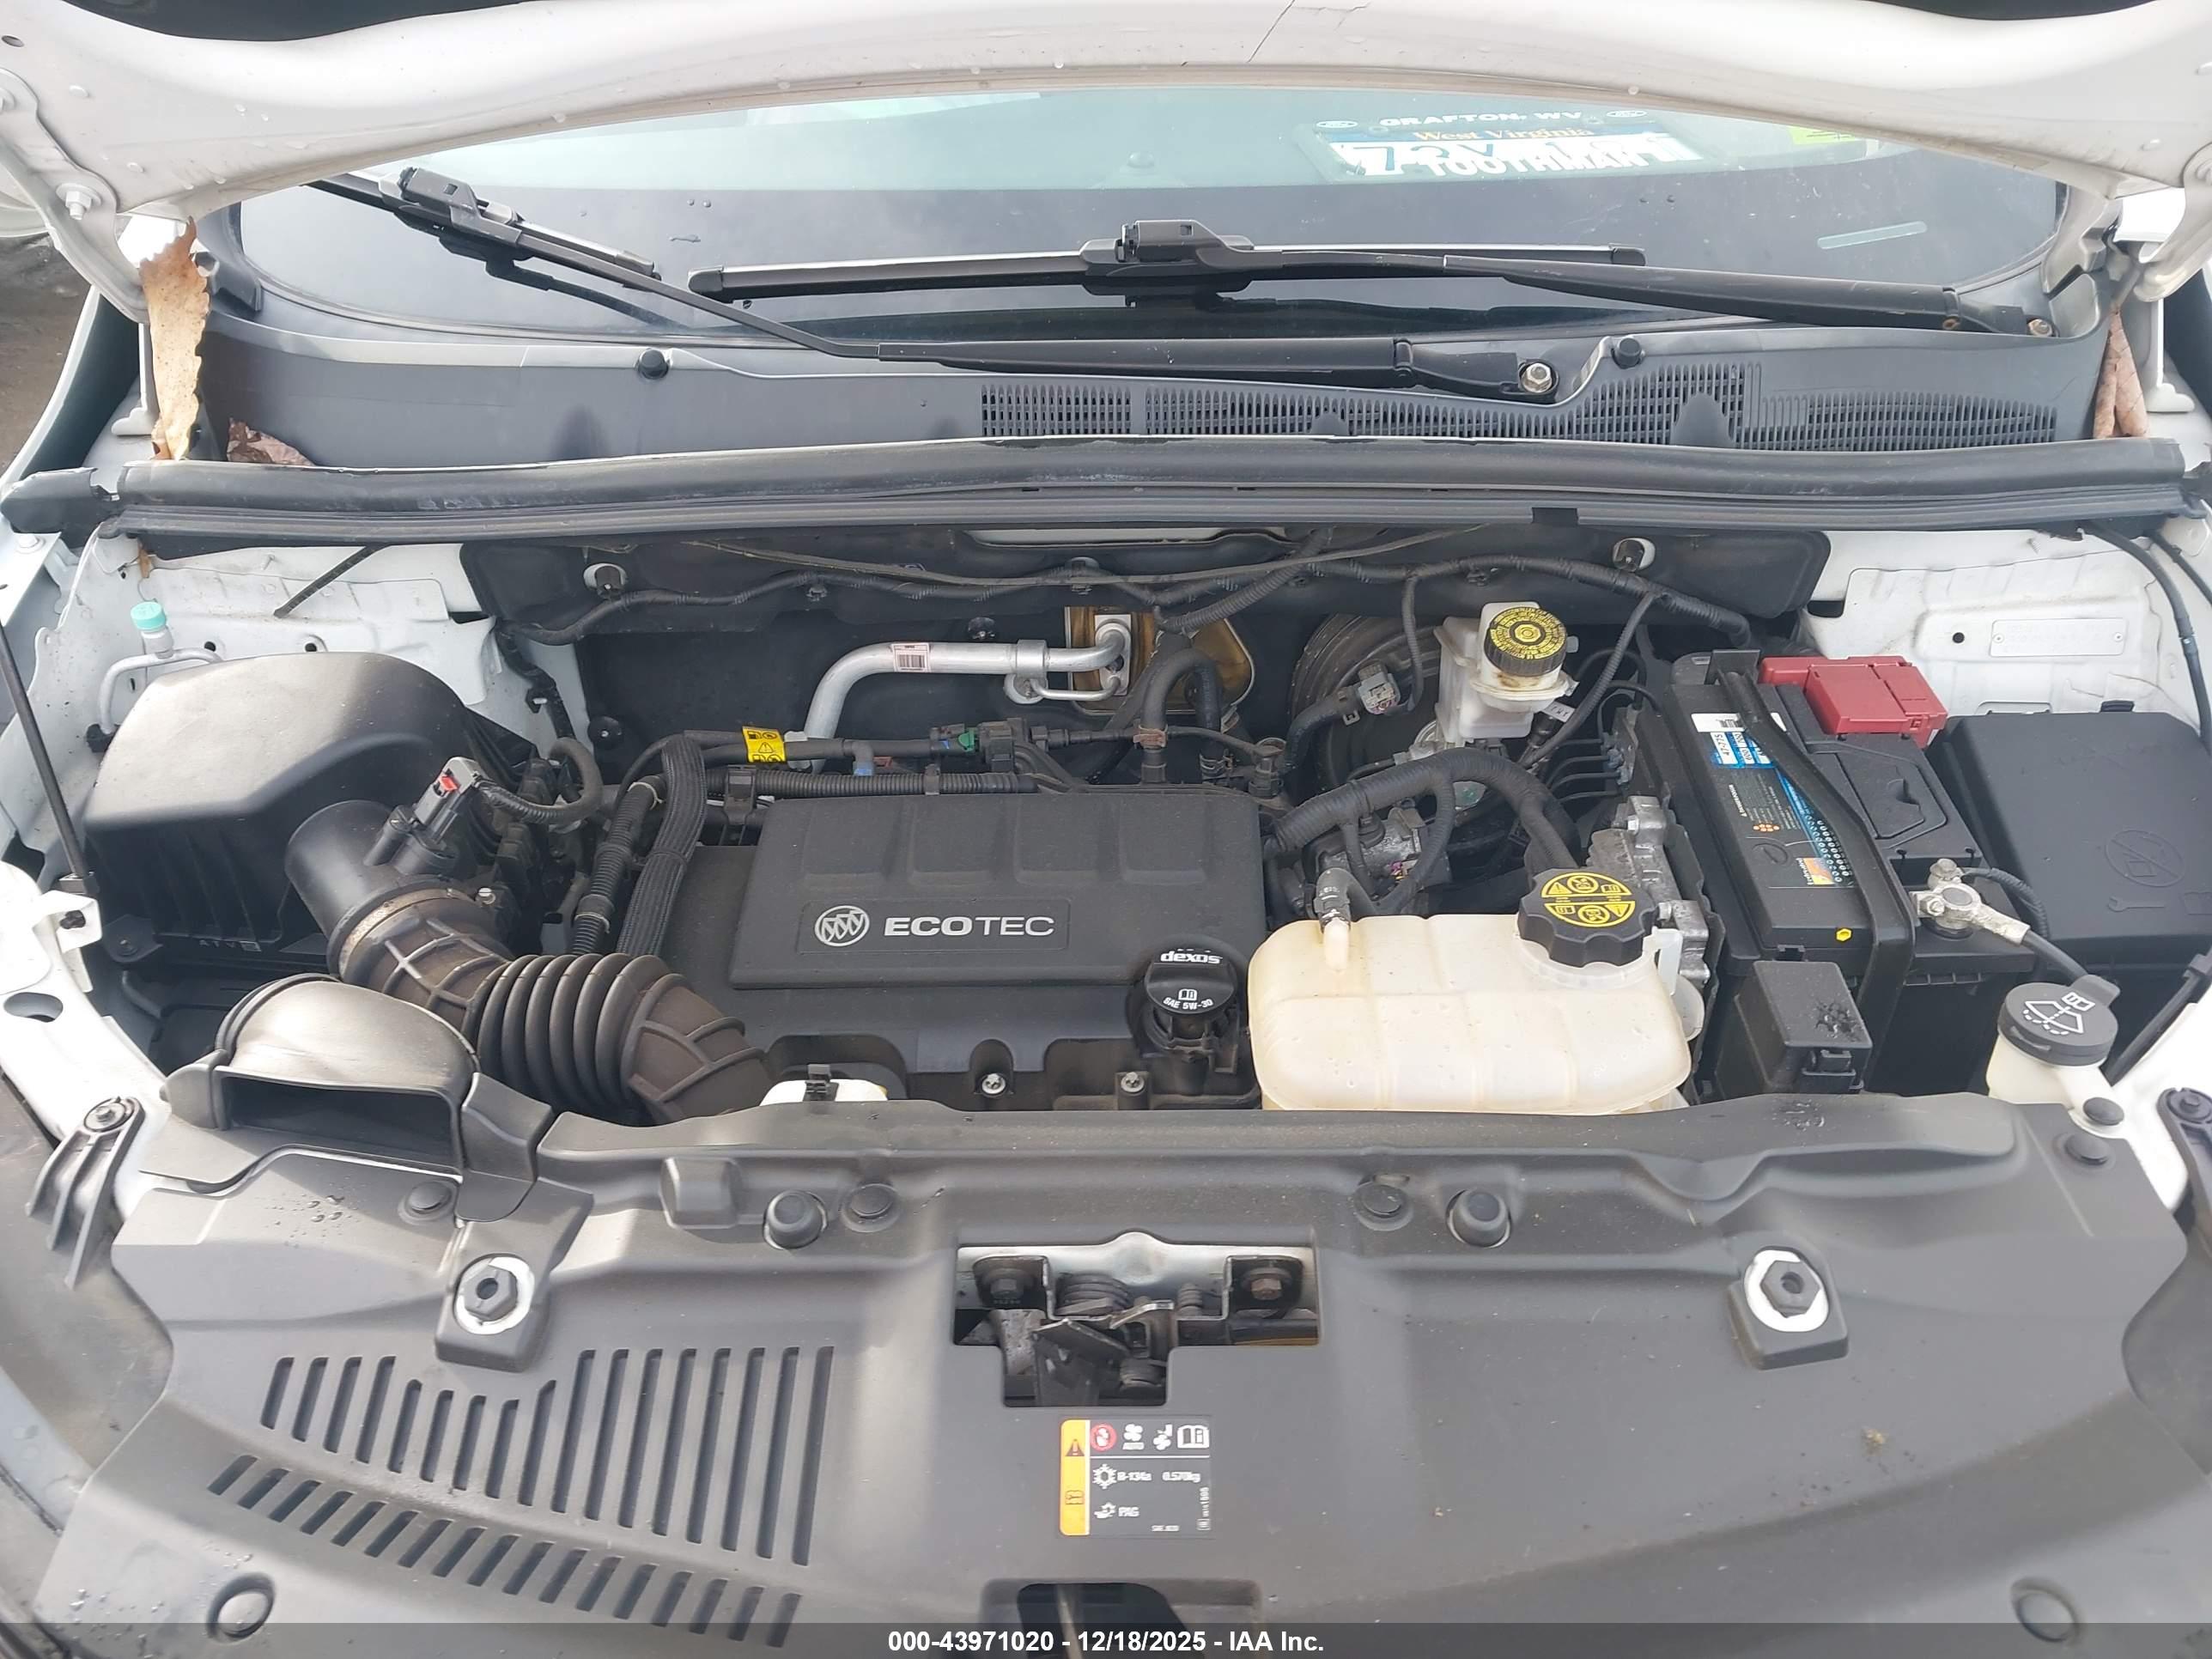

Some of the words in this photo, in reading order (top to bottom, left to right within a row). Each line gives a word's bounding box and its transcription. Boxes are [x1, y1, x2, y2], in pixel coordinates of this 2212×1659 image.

[1379, 112, 1528, 127] GRAFTON,
[1534, 111, 1582, 120] WV
[1412, 130, 1483, 141] West
[1484, 127, 1595, 139] Virginia
[1419, 143, 1650, 177] TOOTHMAN
[884, 916, 1055, 936] ECOTEC
[1160, 951, 1223, 964] dexos
[1163, 997, 1181, 1009] SAE
[1182, 999, 1214, 1011] 5W-30
[1118, 1506, 1140, 1517] PAG
